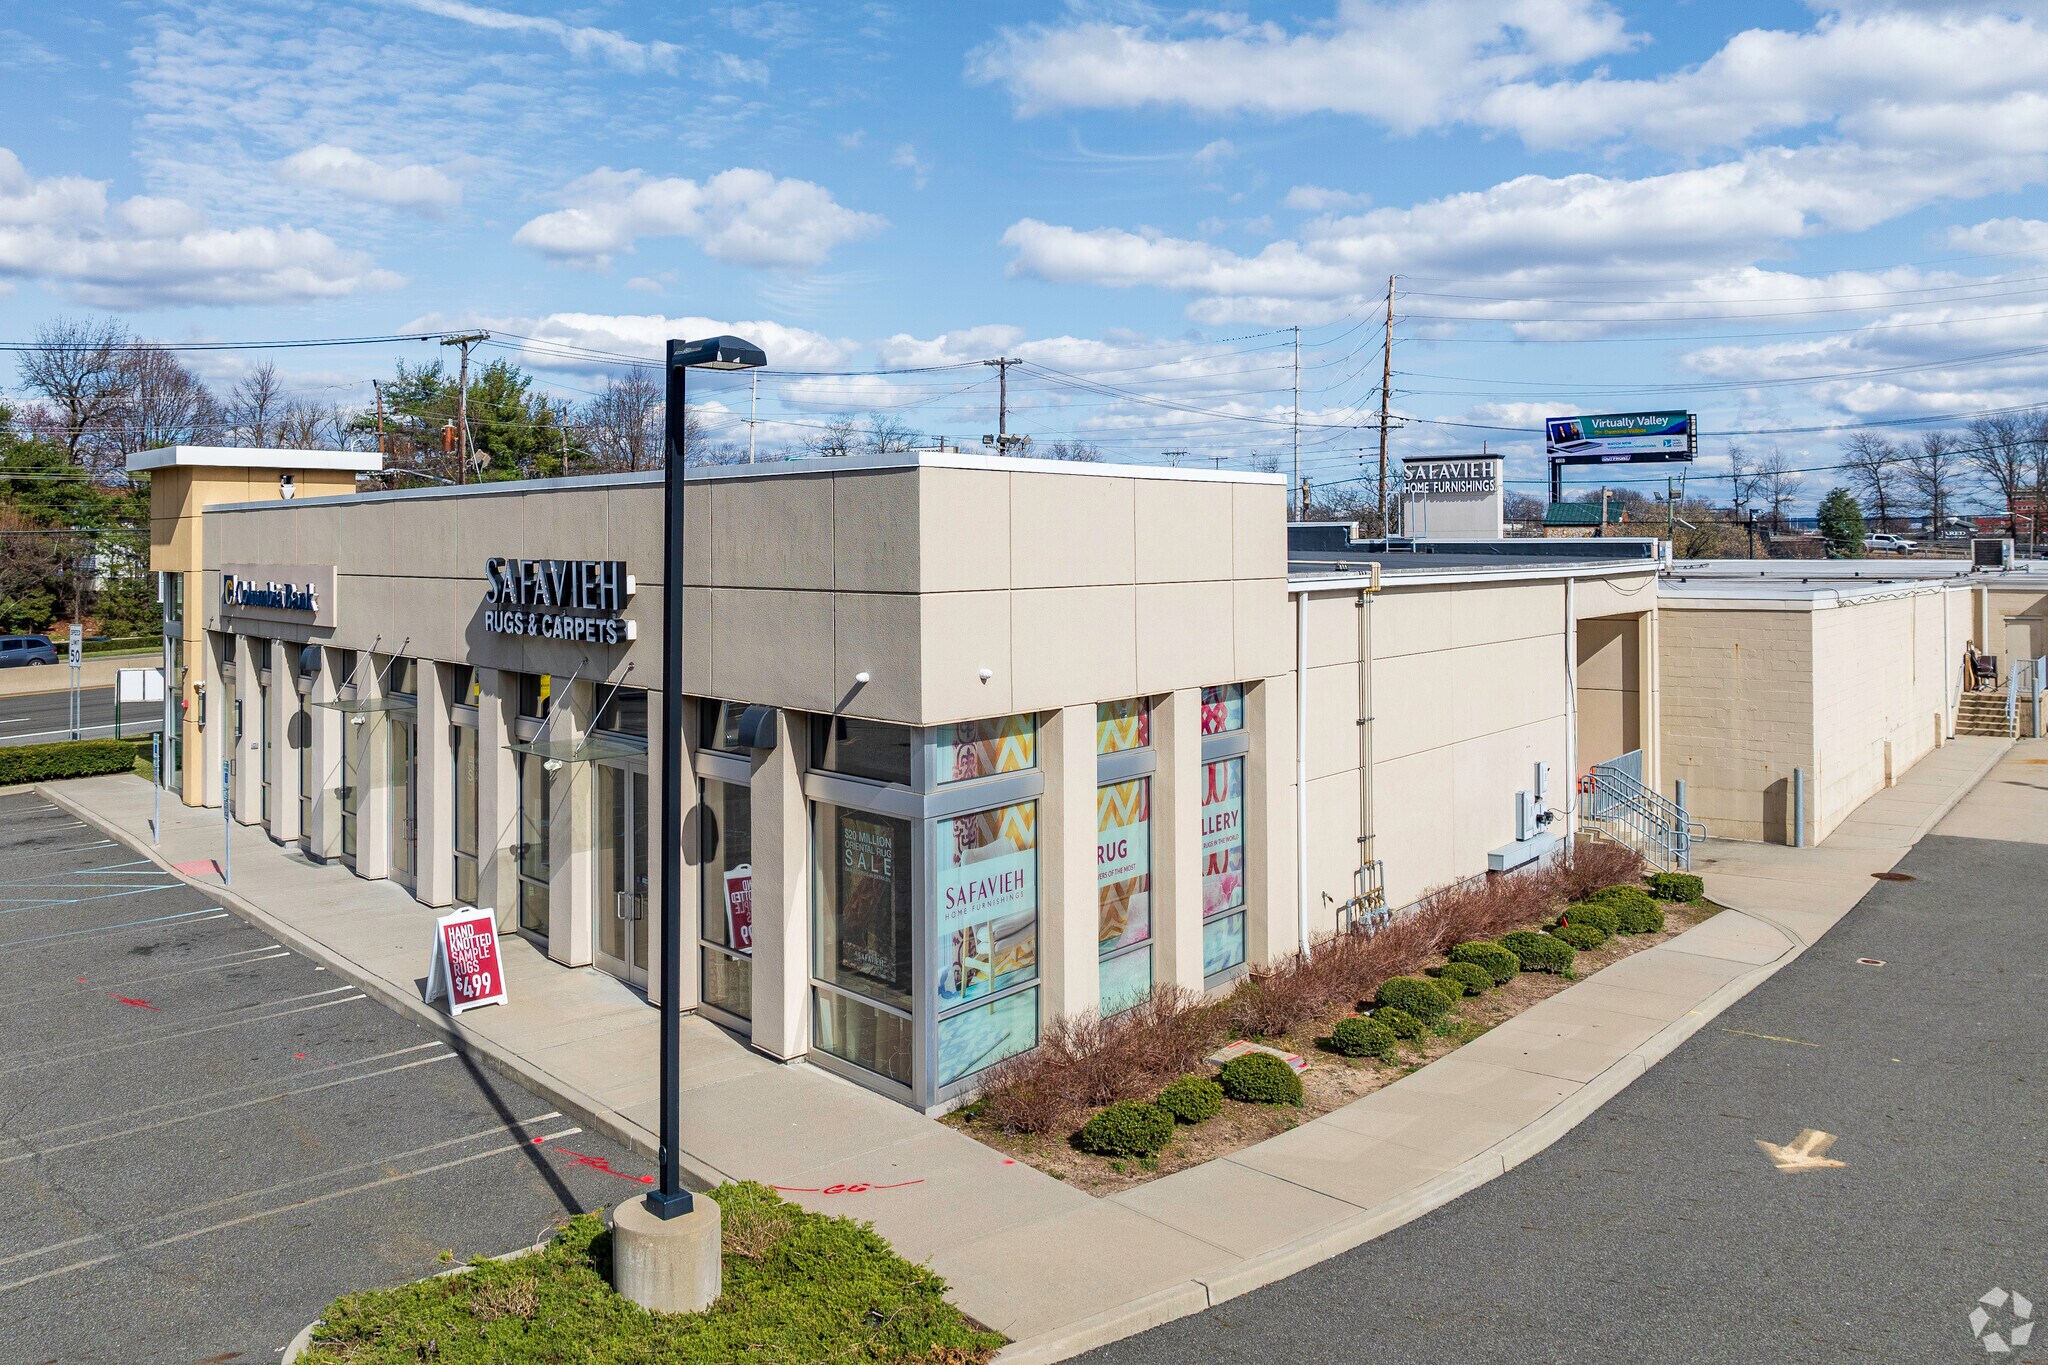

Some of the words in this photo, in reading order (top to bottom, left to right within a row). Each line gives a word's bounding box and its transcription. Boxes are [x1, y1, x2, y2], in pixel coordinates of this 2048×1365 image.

[1592, 417, 1634, 428] Virtually
[1637, 416, 1668, 427] Valley
[1403, 461, 1495, 480] SAFAVIEH
[1403, 481, 1429, 494] HOME
[1433, 480, 1495, 493] FURNISHINGS
[485, 557, 620, 610] SAFAVIEH
[284, 583, 318, 611] Bank
[485, 610, 525, 635] RUGS
[527, 613, 538, 637] &
[541, 614, 618, 645] CARPETS
[70, 649, 80, 663] 50
[1202, 809, 1239, 836] LLERY
[844, 828, 857, 840] $20
[858, 831, 892, 848] MILLION
[844, 840, 874, 855] ORIENTAL
[876, 848, 892, 858] RUG
[1098, 839, 1127, 865] RUG
[845, 849, 892, 876] SALE
[946, 868, 1024, 910] SAFAVIEH
[945, 907, 968, 921] HOME
[971, 890, 1024, 912] FURNISHINGS
[448, 924, 475, 940] HAND
[450, 933, 492, 952] KNOTTED
[451, 945, 491, 963] SAMPLE
[454, 960, 480, 976] RUGS
[456, 972, 492, 998] $499
